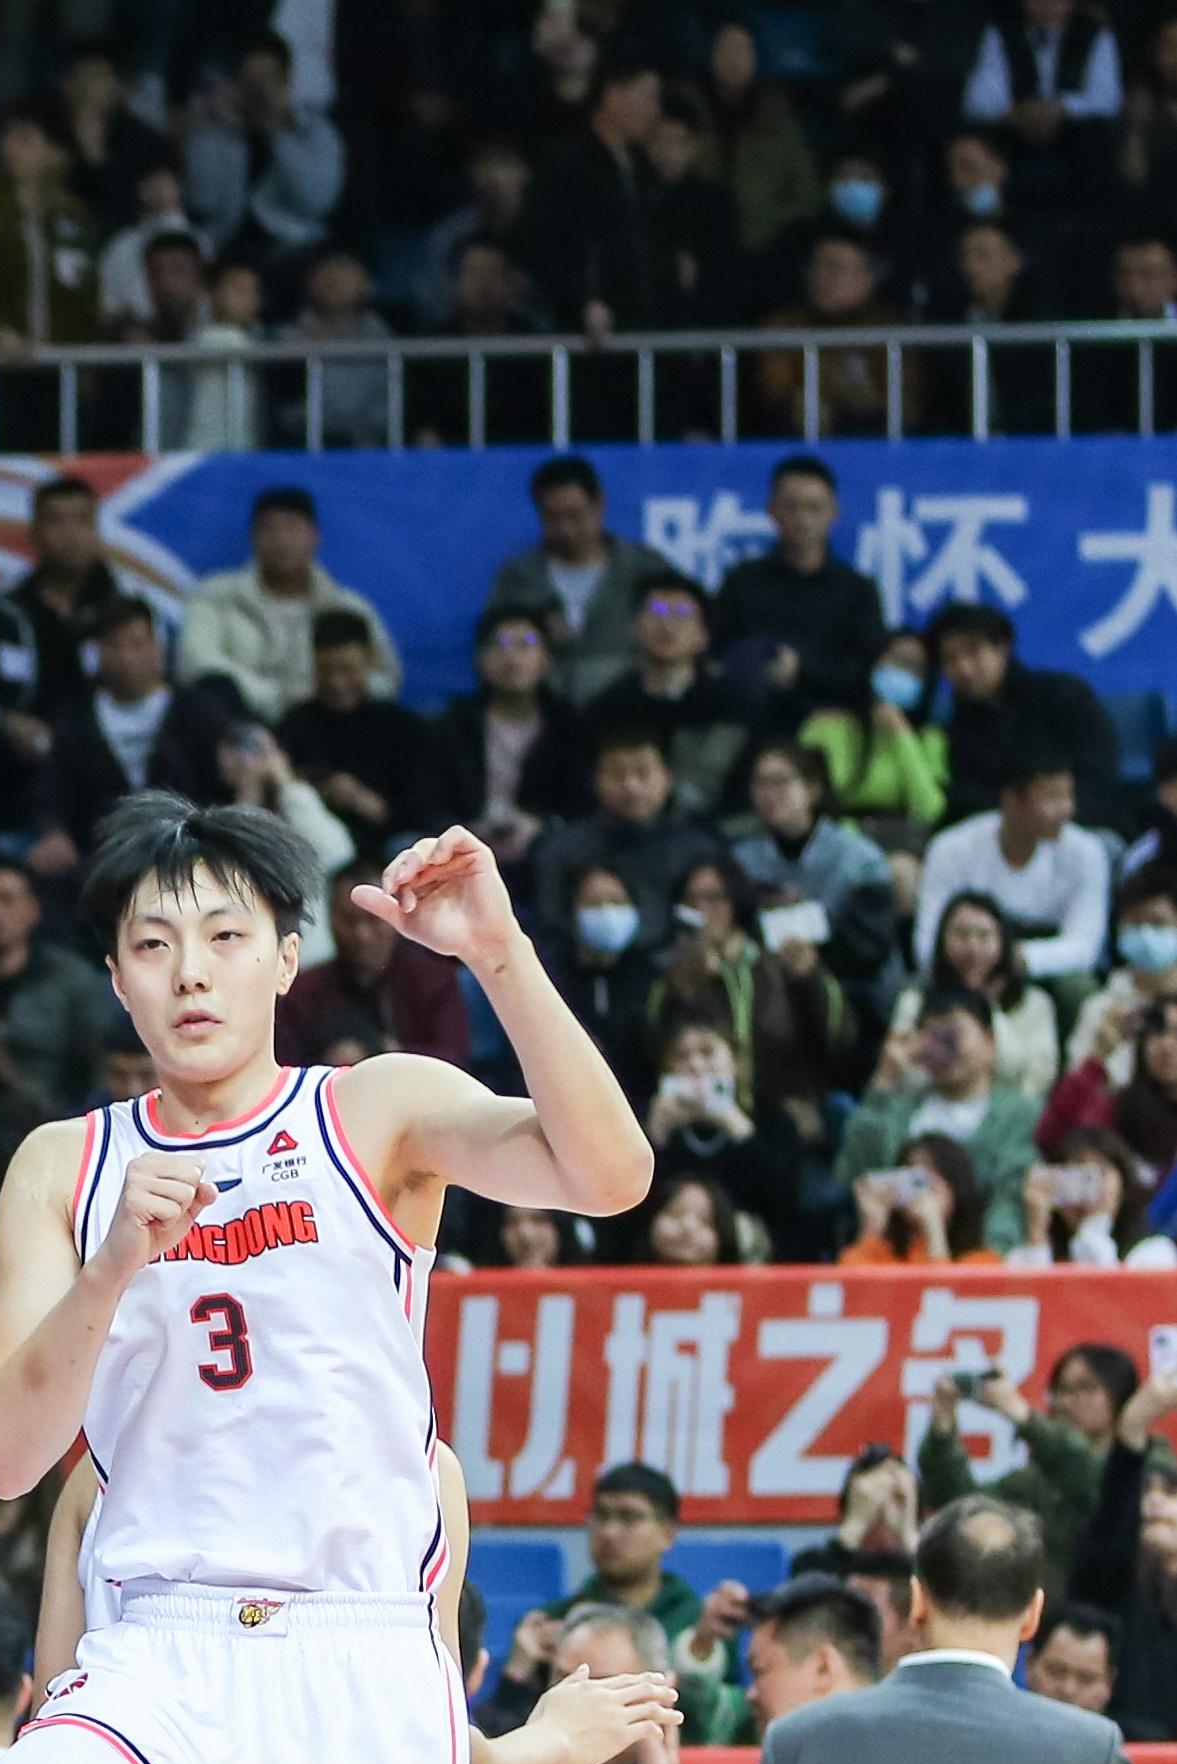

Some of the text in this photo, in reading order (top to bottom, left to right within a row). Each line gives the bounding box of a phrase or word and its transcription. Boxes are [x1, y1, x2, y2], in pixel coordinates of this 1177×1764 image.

[271, 1168, 299, 1182] CGB
[149, 1200, 318, 1265] NGDONG
[190, 1293, 253, 1391] 3
[452, 1283, 1039, 1500] 以城之名
